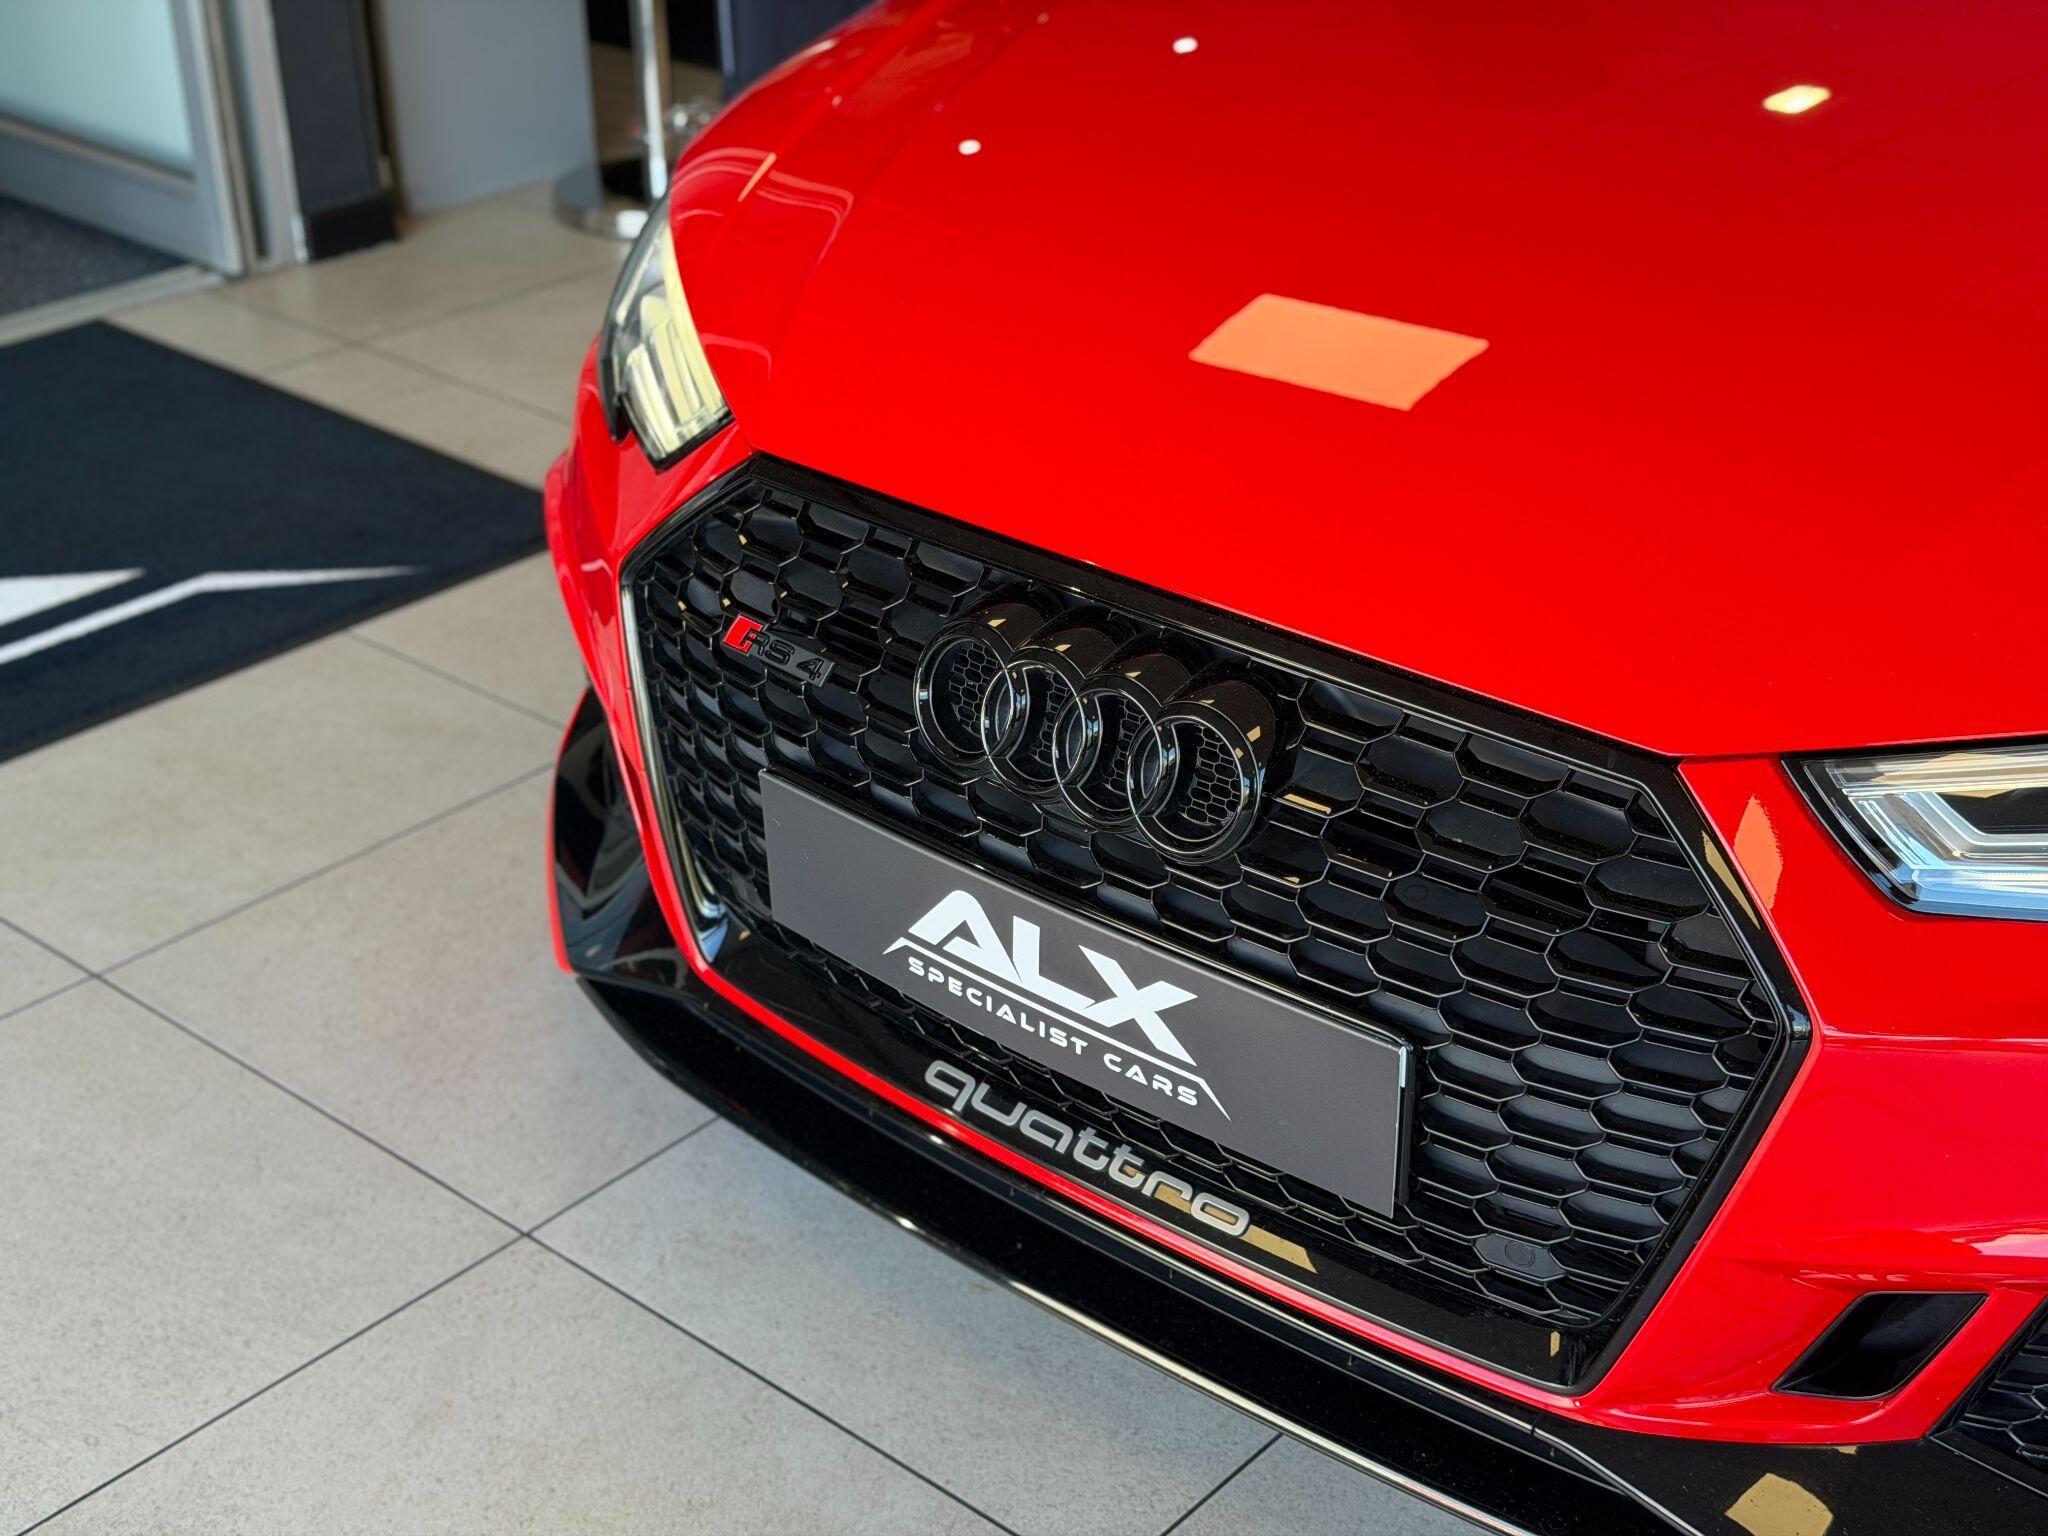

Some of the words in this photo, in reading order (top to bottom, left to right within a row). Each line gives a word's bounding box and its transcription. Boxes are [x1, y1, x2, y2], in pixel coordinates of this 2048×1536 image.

[907, 956, 1088, 1055] SPECIALIST
[1103, 1053, 1198, 1106] CARS
[908, 890, 1199, 1067] ALX
[925, 1059, 1251, 1236] quattro
